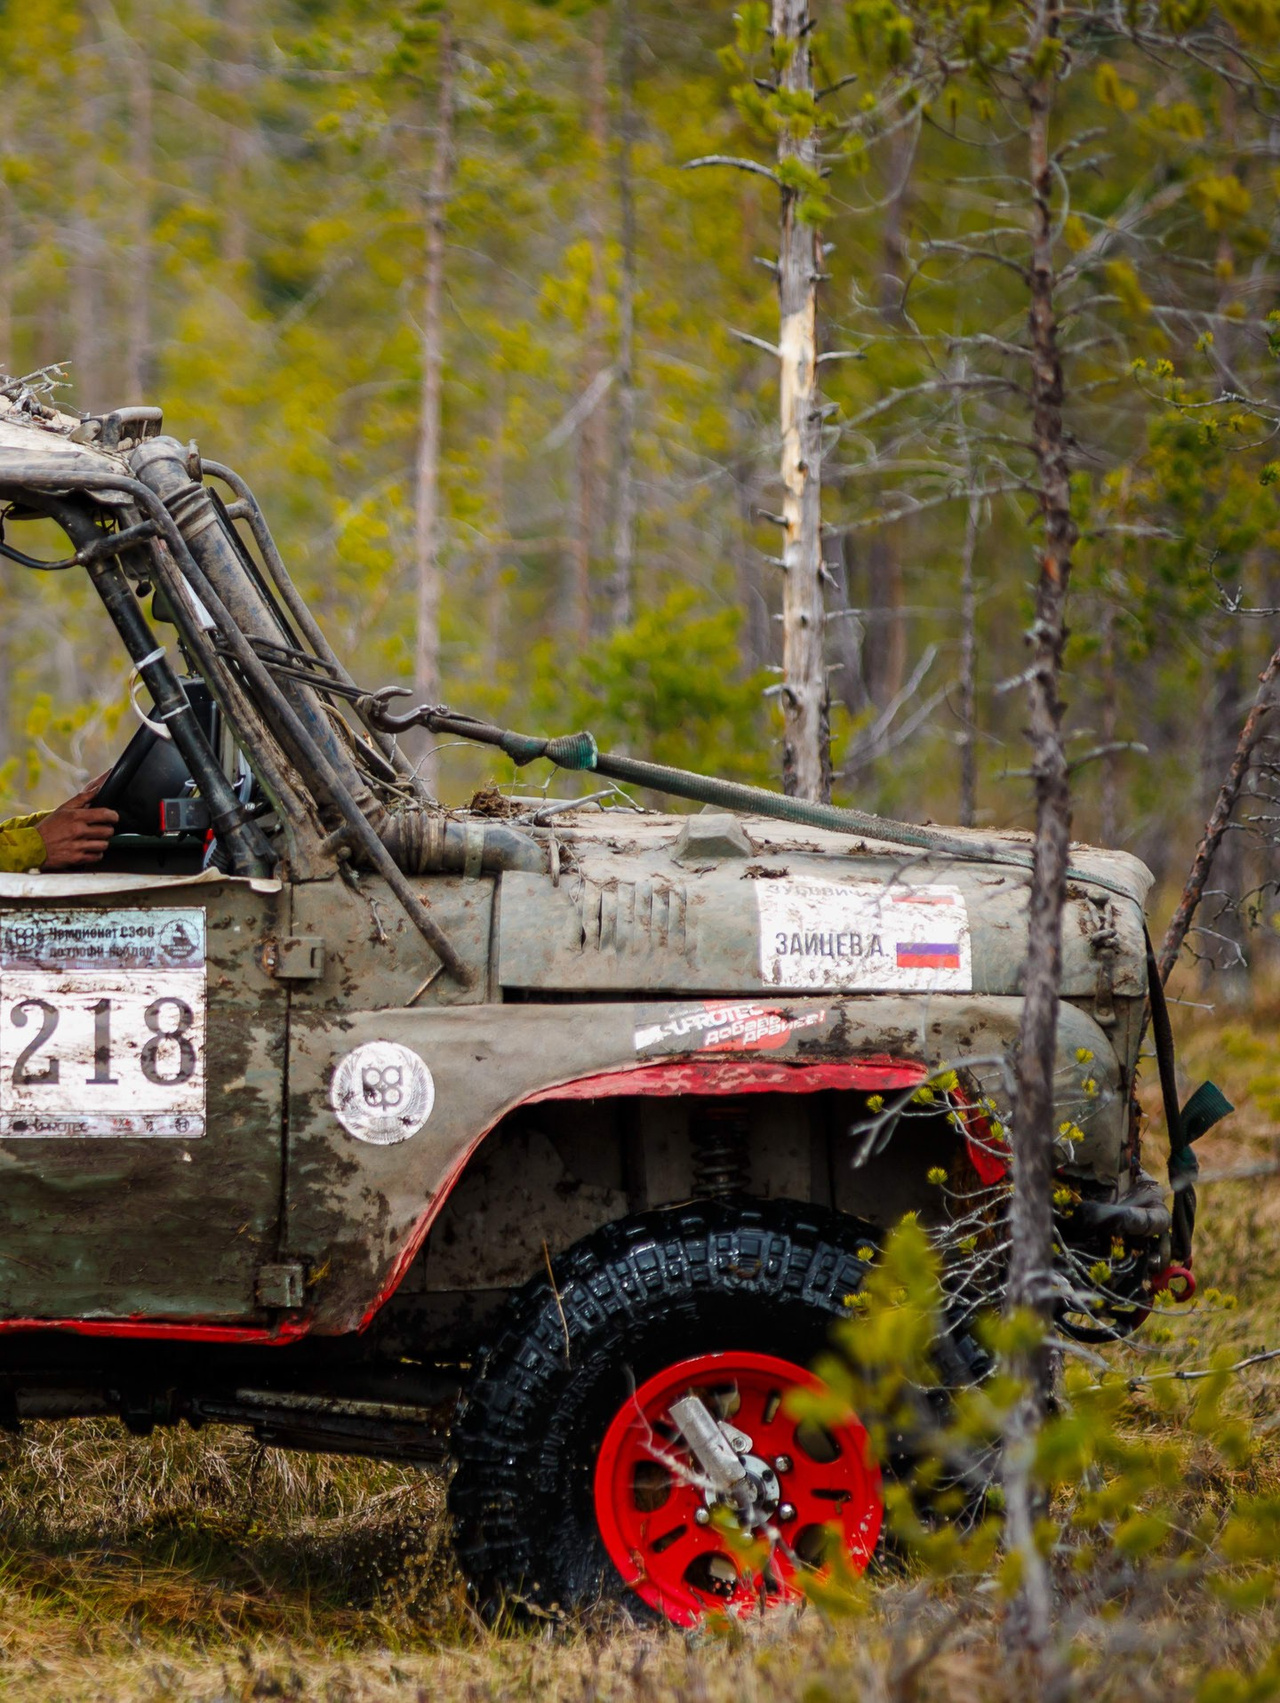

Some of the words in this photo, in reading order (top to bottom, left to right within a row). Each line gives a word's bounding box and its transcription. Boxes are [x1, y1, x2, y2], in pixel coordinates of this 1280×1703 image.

[775, 928, 863, 960] ЗАЙЦЕВ
[657, 1003, 764, 1038] SUPROTEC
[10, 996, 196, 1087] 218
